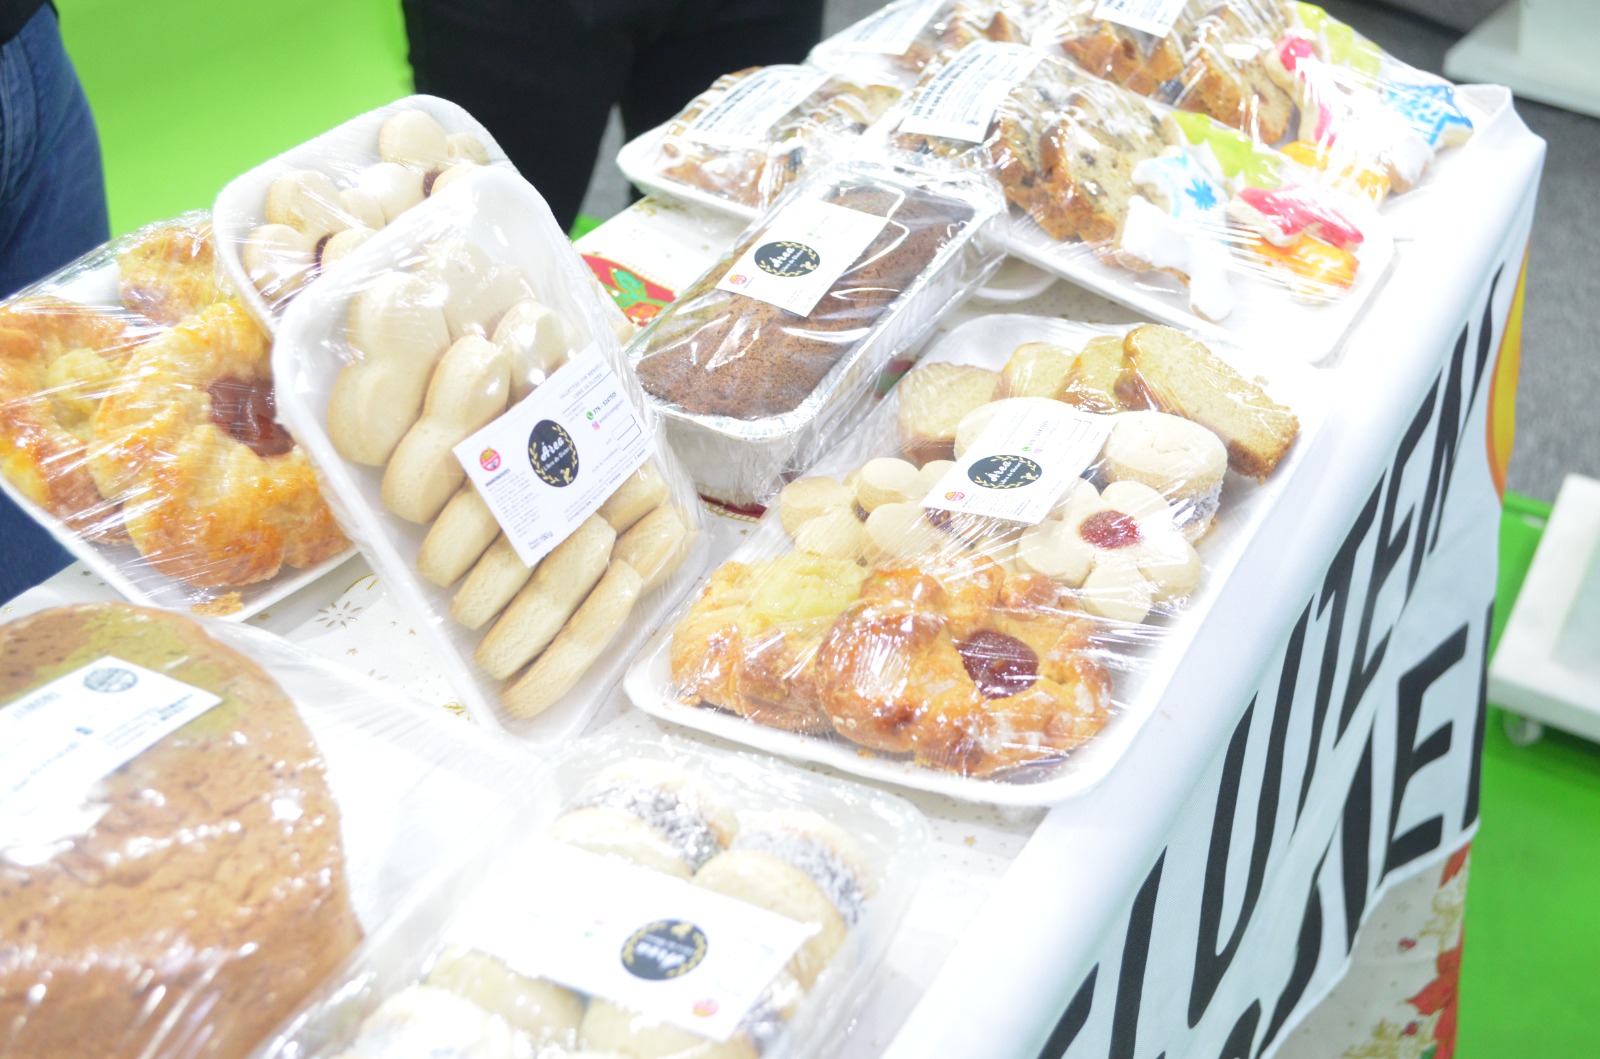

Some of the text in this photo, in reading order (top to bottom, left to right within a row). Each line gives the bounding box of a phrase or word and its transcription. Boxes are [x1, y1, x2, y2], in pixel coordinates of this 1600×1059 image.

[540, 436, 564, 462] Área
[985, 461, 1011, 482] Área
[1037, 262, 1505, 1059] LUTEN
